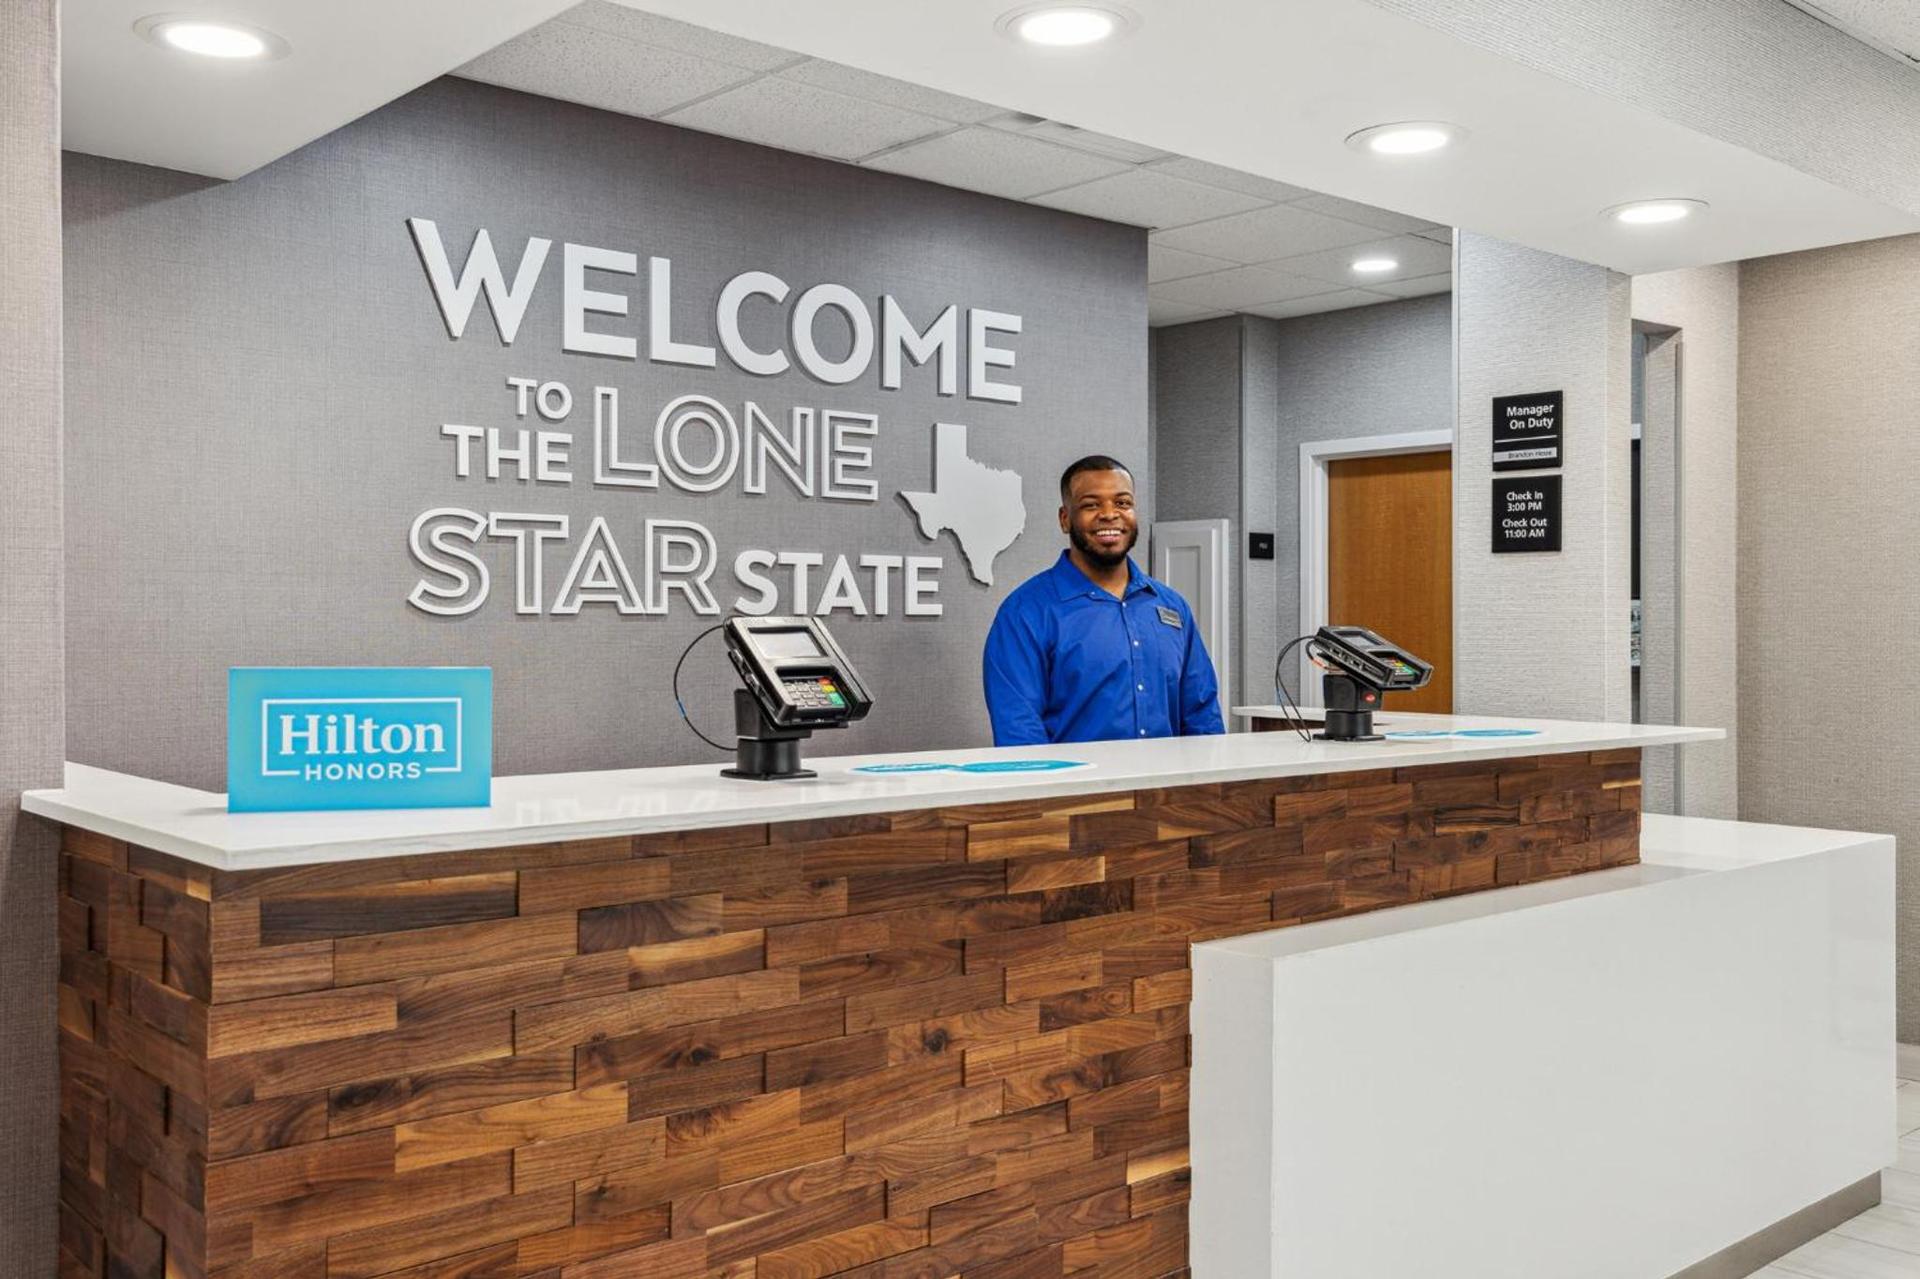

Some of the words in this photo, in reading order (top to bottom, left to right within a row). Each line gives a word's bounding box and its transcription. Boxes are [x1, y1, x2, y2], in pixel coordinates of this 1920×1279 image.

[405, 217, 1022, 403] WELCOME
[507, 376, 573, 420] TO
[1506, 404, 1555, 417] Manager
[1509, 420, 1525, 430] On
[1528, 417, 1554, 430] Duty
[441, 424, 573, 482] THE
[593, 386, 879, 501] LONE
[1506, 491, 1532, 501] Check
[1534, 491, 1543, 500] In
[1507, 502, 1525, 512] 3:00
[1527, 501, 1542, 511] PM
[1502, 518, 1528, 528] Check
[1530, 517, 1547, 527] Out
[1504, 529, 1527, 538] 11:00
[1528, 528, 1545, 538] AM
[407, 507, 720, 616] STAR
[734, 550, 943, 617] STATE
[279, 714, 446, 755] Hilton
[305, 762, 421, 781] HONORS
